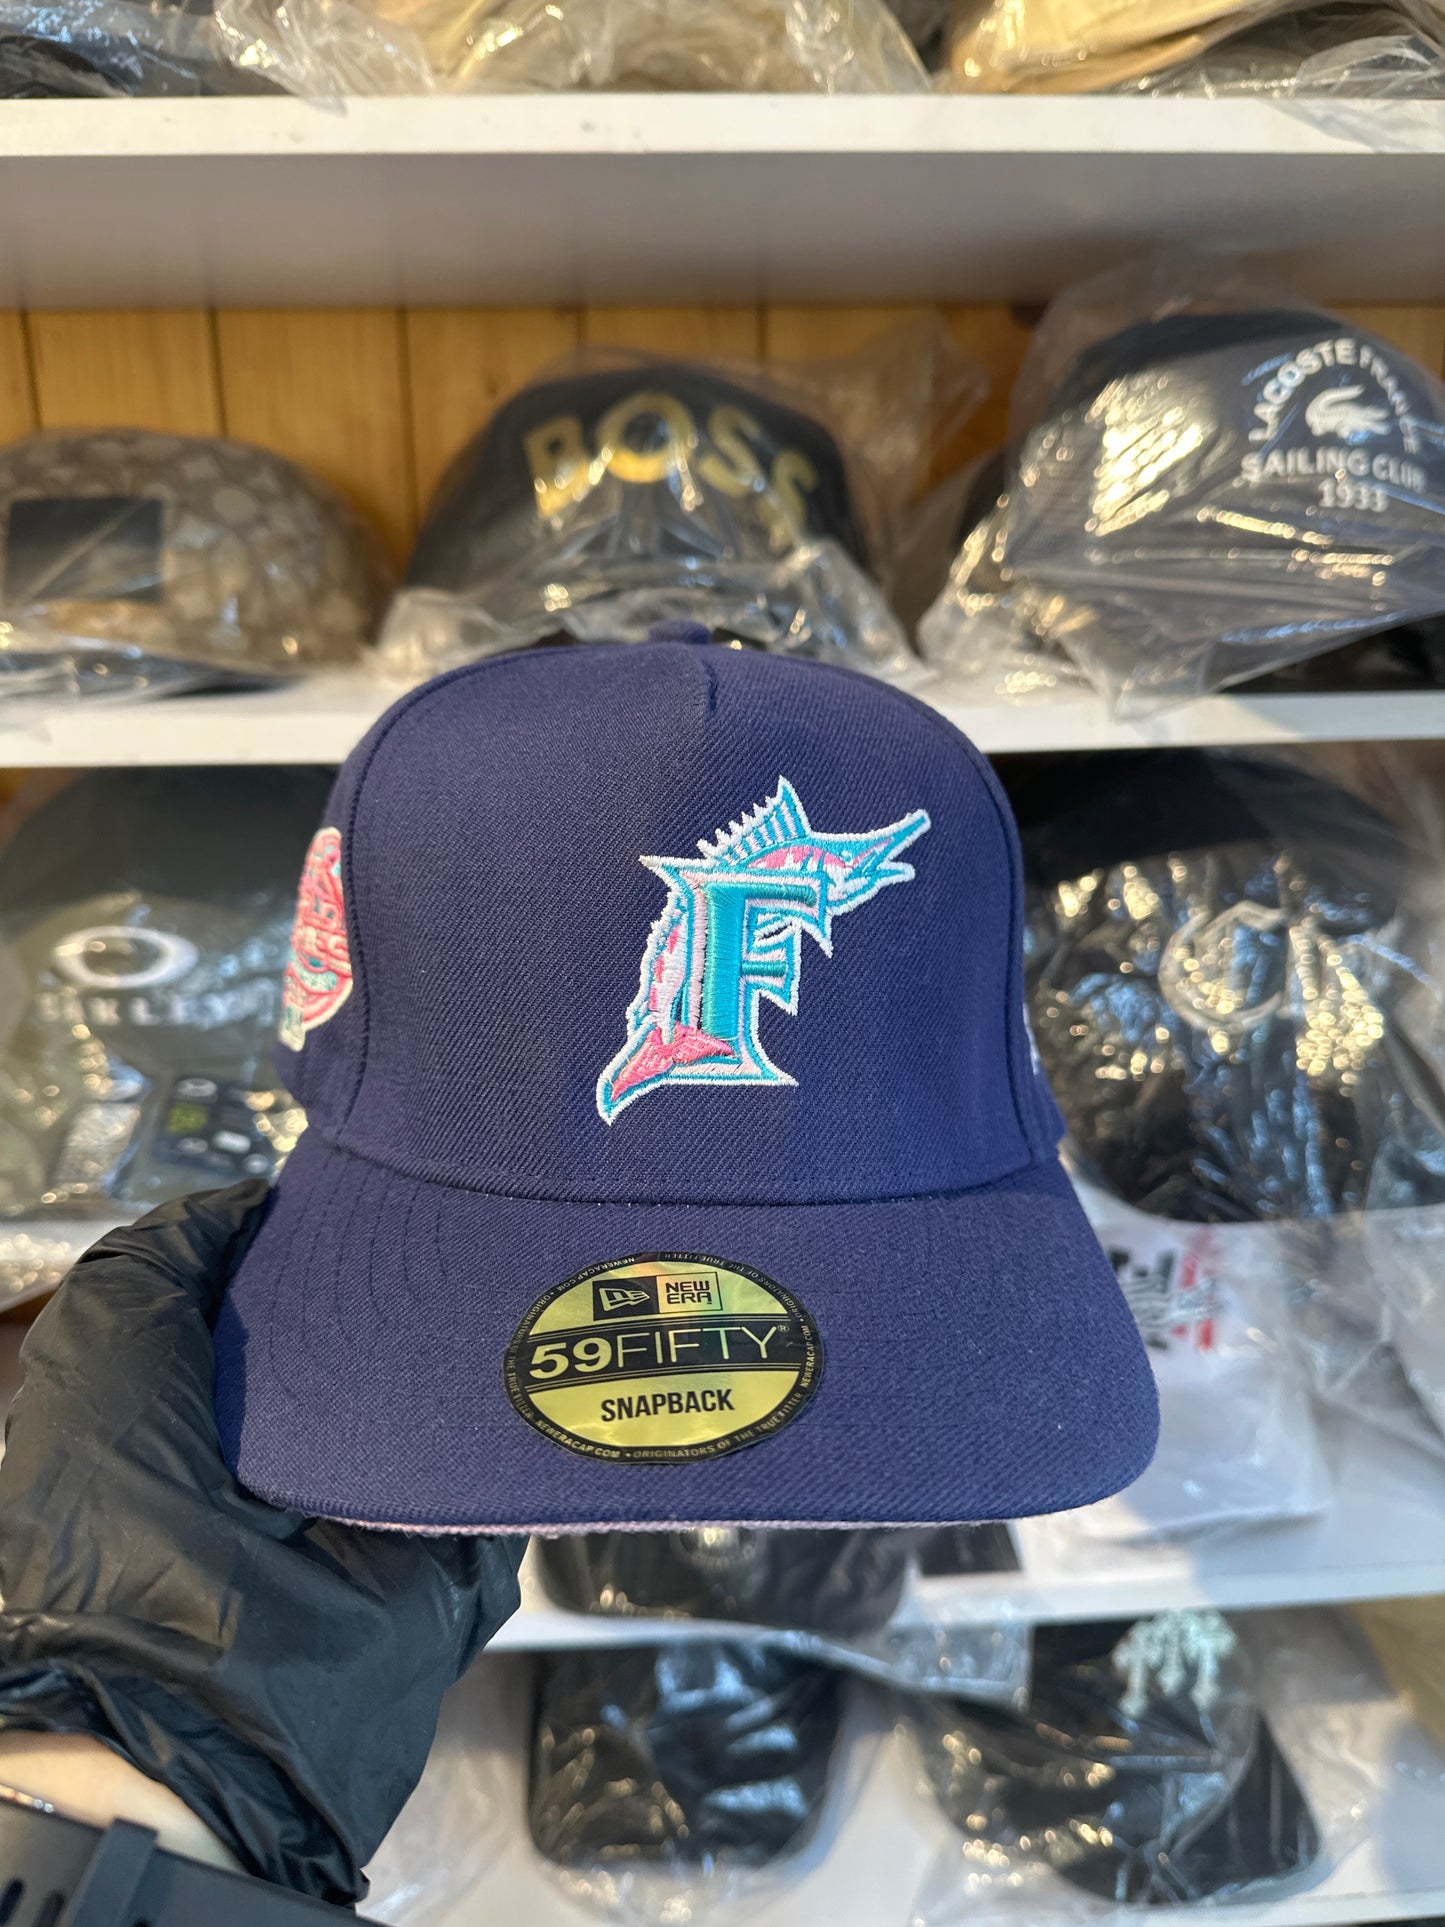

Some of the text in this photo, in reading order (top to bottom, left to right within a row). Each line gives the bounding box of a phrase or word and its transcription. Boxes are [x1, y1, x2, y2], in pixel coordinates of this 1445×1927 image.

[1248, 337, 1358, 441] LACOSTE
[524, 392, 818, 552] BOSS
[1241, 446, 1371, 482] SAILING
[1318, 478, 1390, 513] 1933
[665, 1281, 710, 1293] NEW
[666, 1291, 712, 1305] ERA
[601, 1389, 735, 1422] SNAPBACK
[633, 1444, 715, 1458] ORIGINATORS
[717, 1438, 732, 1449] OF
[734, 1430, 755, 1442] THE
[756, 1415, 781, 1434] TRUE
